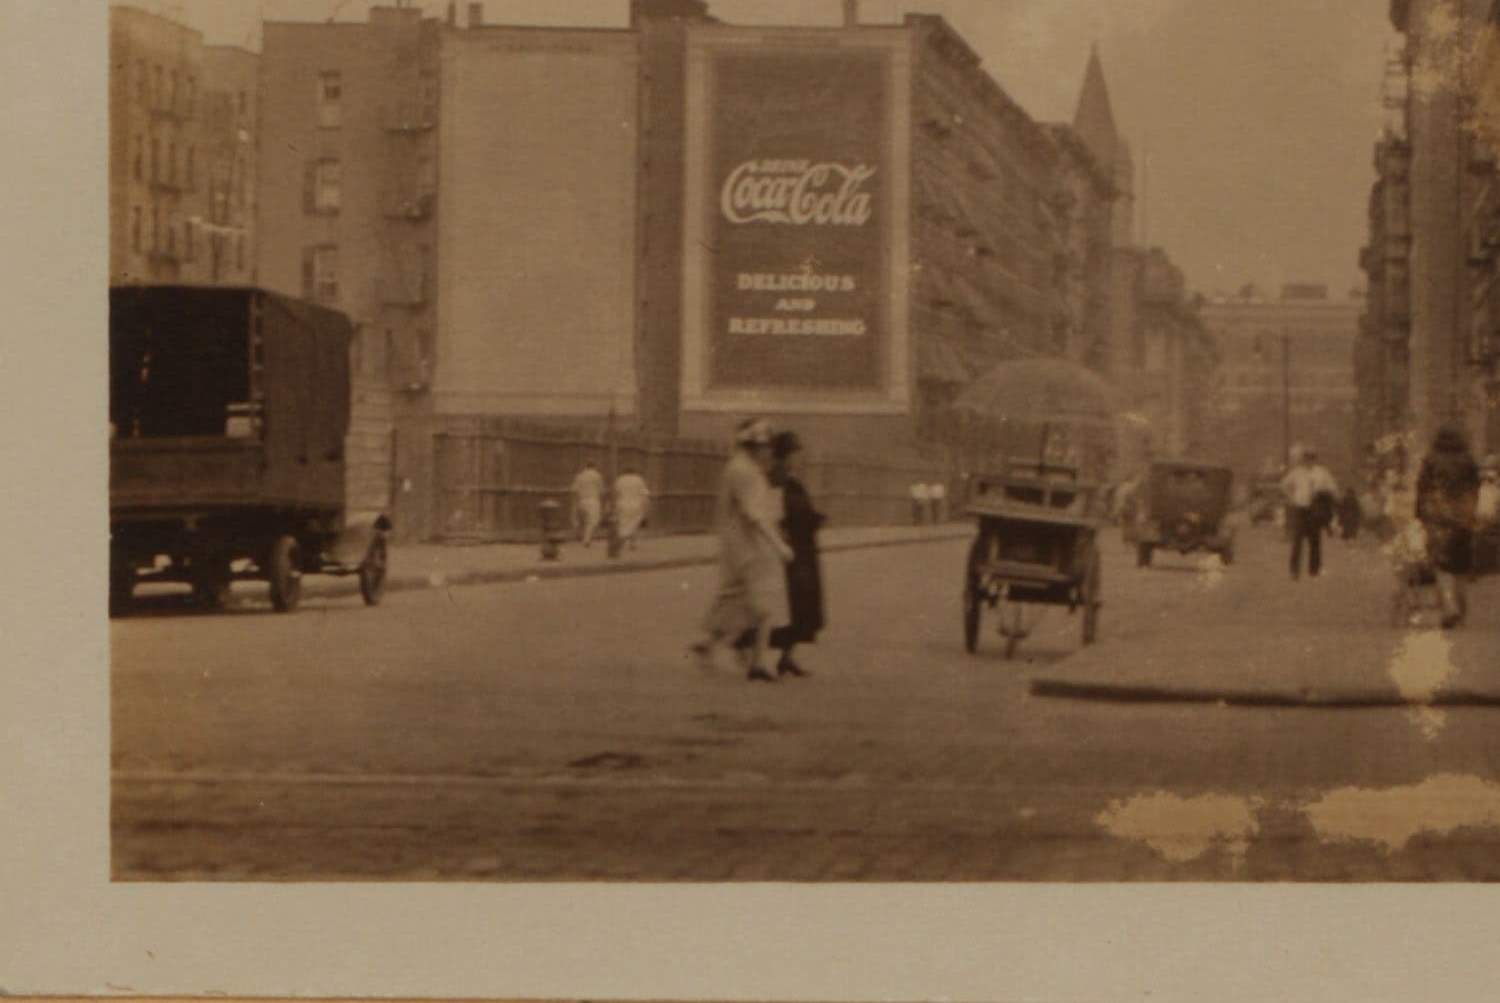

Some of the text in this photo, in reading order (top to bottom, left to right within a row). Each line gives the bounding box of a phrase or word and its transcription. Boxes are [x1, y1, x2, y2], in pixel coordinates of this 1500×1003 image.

[736, 273, 856, 292] DELICIOUS
[775, 298, 817, 311] AND
[728, 317, 867, 336] REFRESHING
